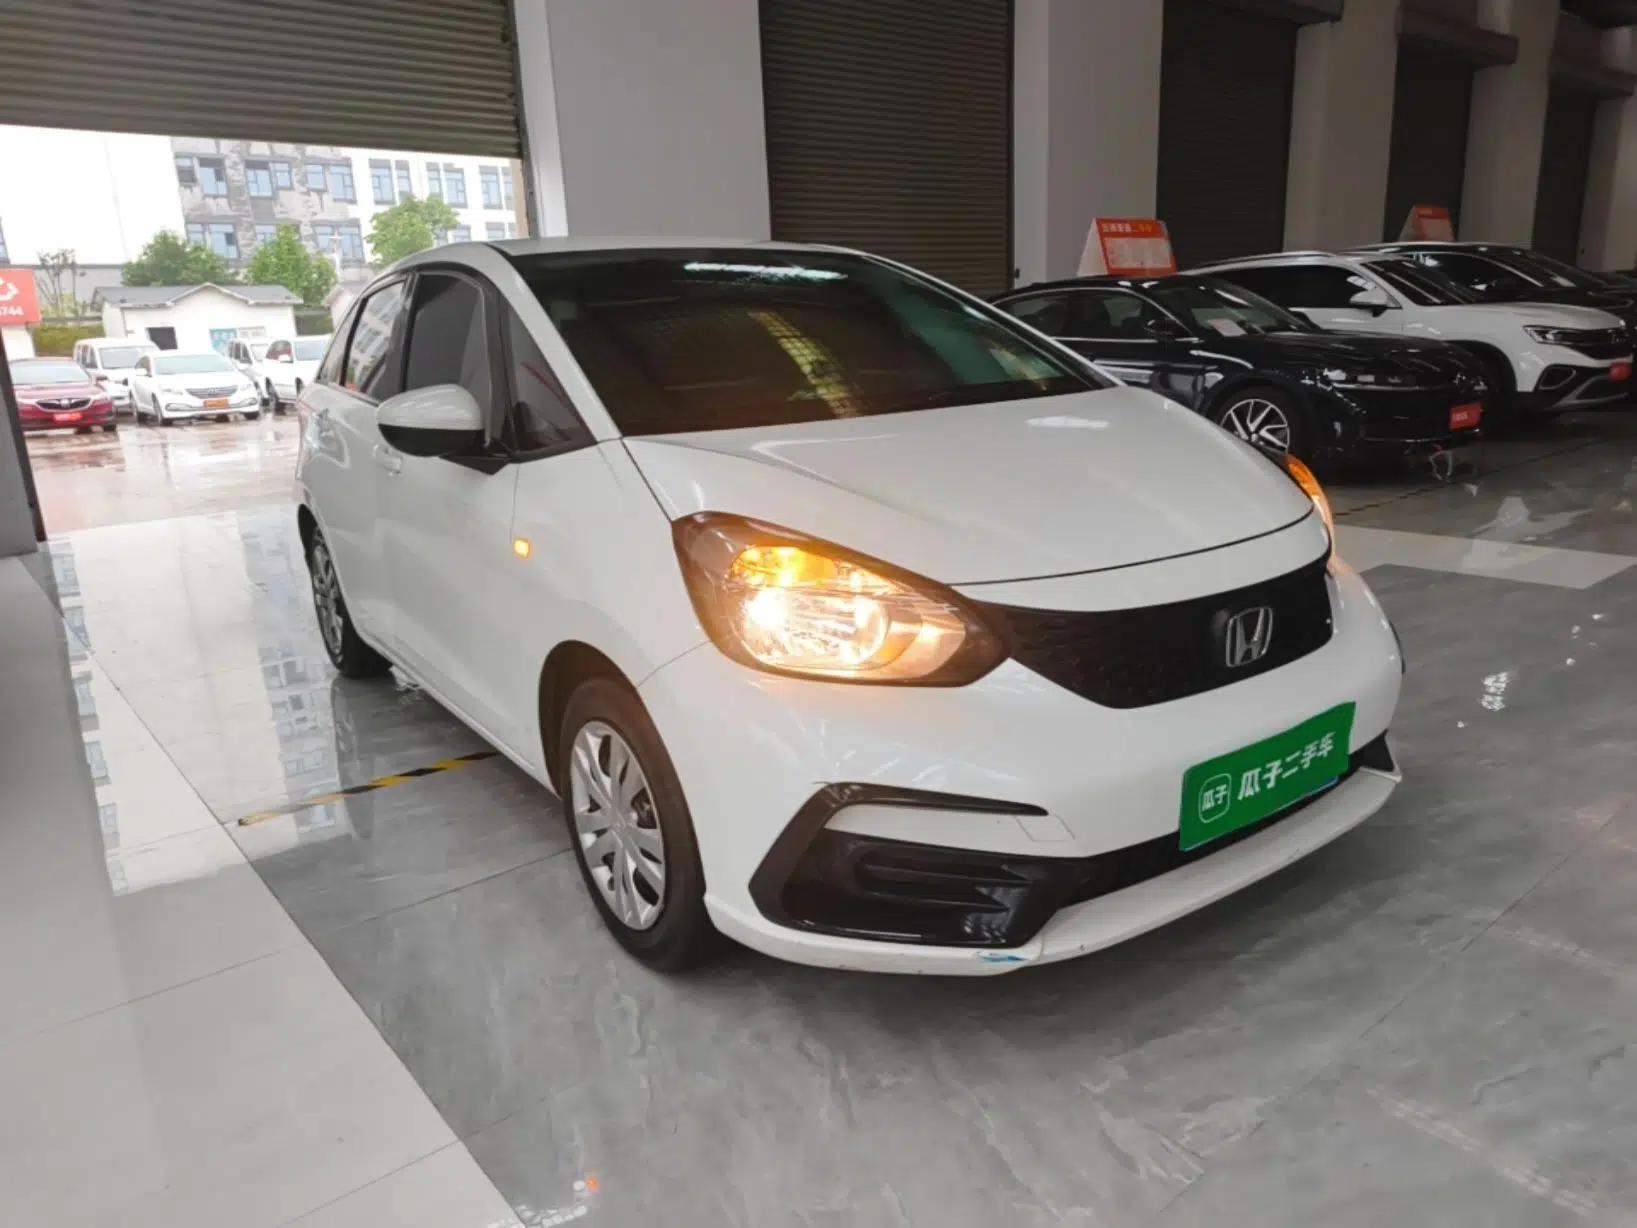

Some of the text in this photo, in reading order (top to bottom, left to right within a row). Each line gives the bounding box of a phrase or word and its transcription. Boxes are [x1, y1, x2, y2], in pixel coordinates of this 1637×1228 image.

[1237, 731, 1336, 800] 瓜子二手车
[1202, 784, 1227, 811] 瓜子
